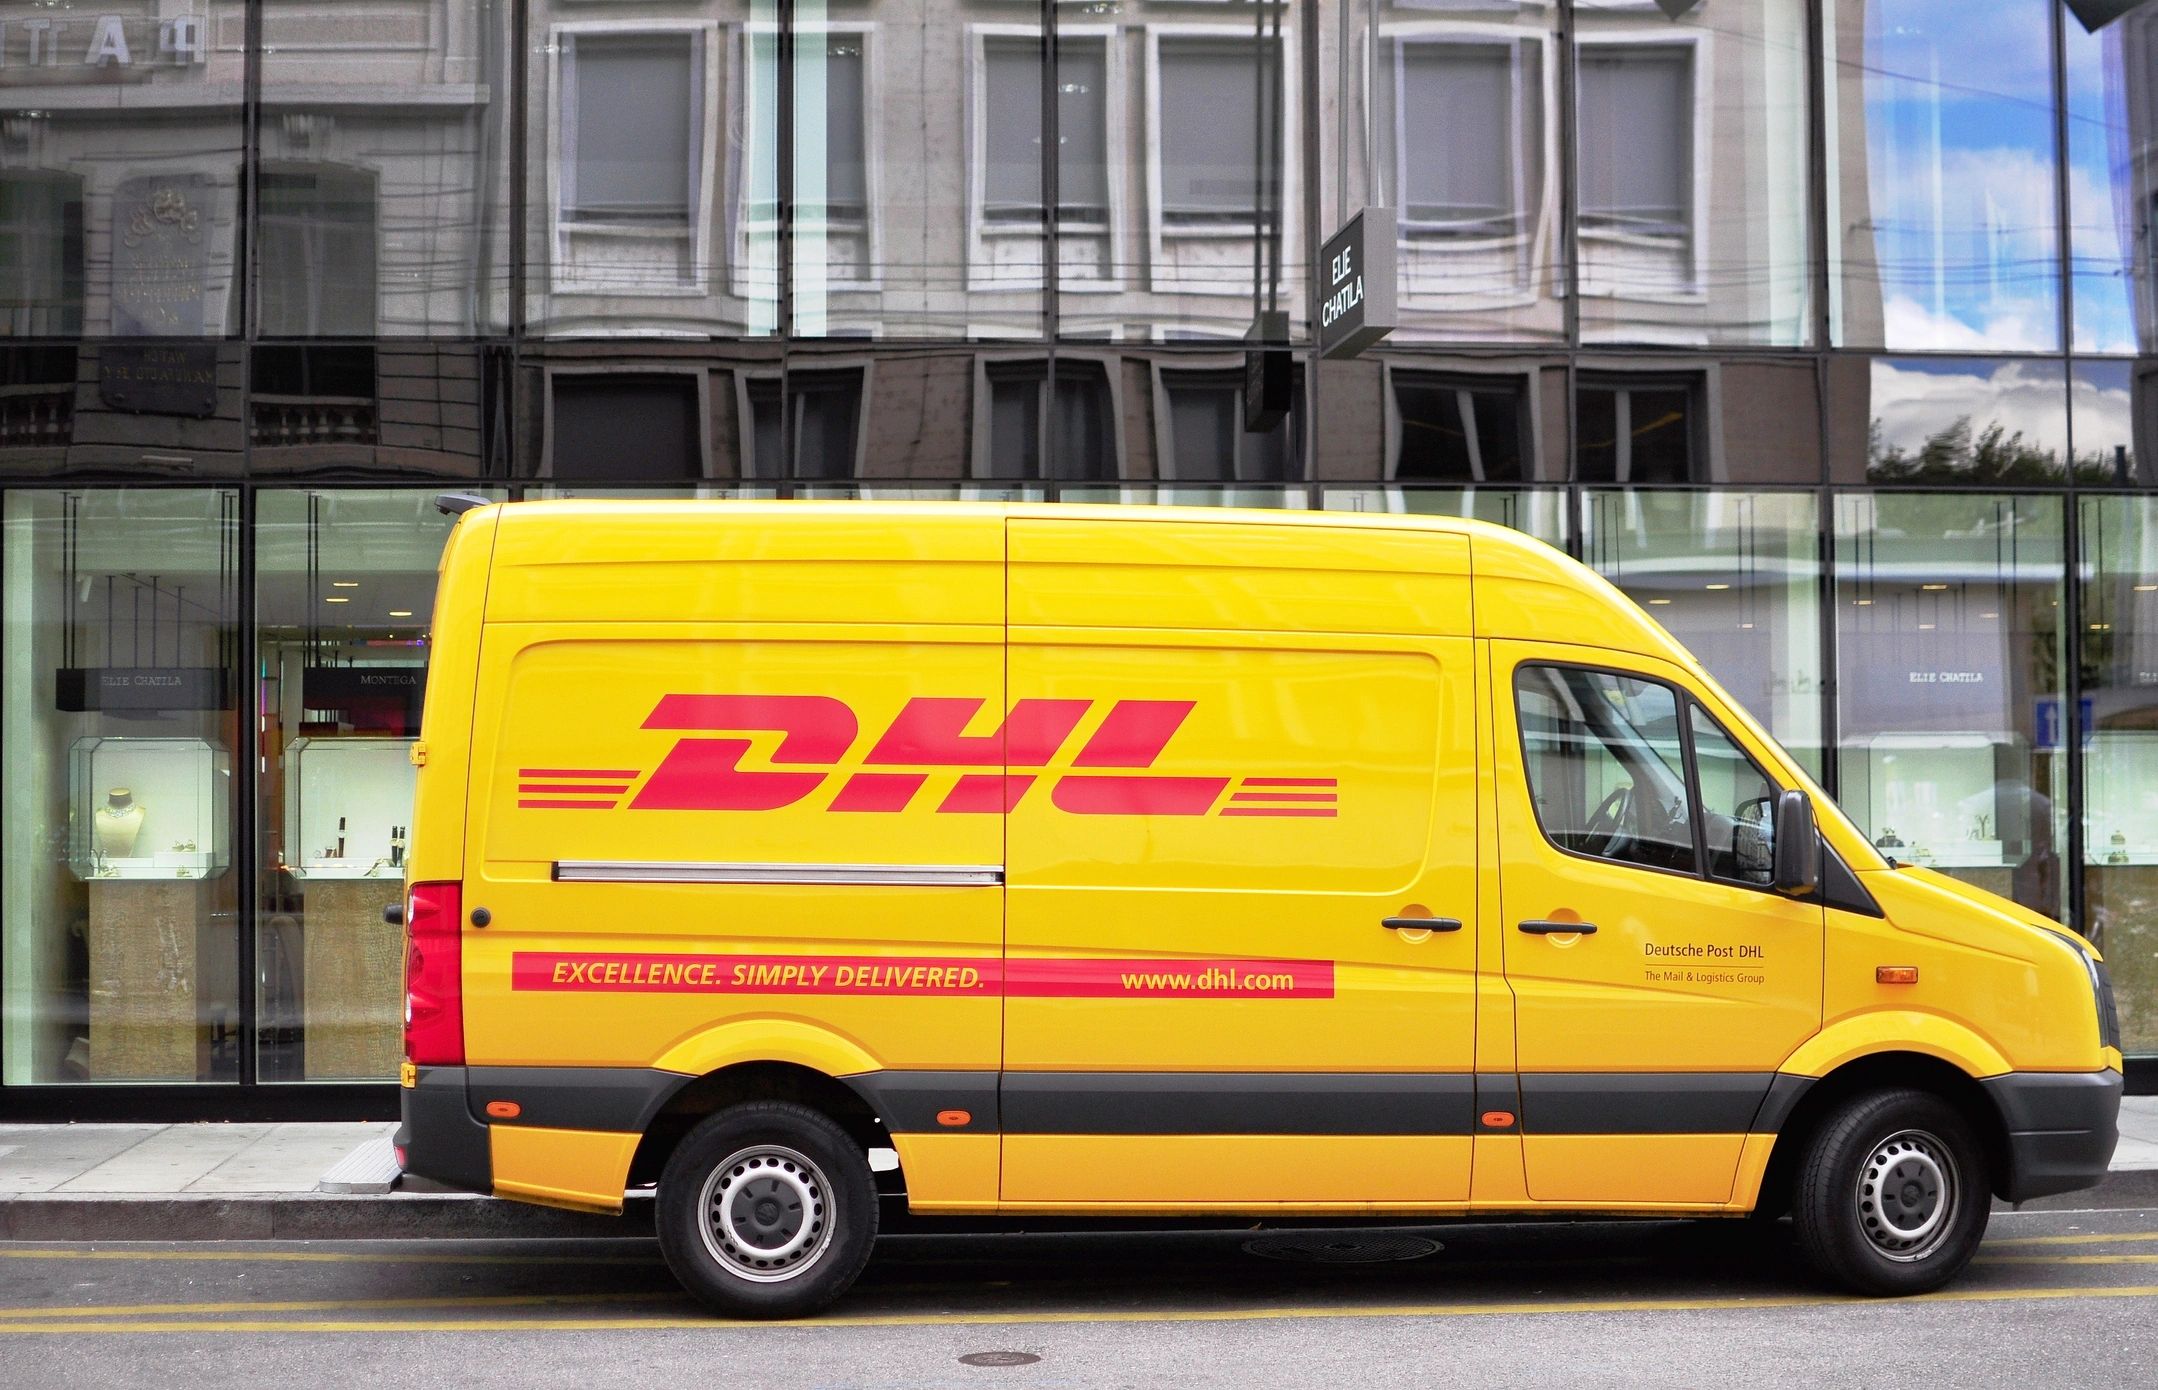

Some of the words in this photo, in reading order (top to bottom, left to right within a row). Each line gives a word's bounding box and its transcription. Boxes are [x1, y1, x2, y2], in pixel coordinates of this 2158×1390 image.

[1332, 245, 1351, 286] ELIE
[1322, 275, 1364, 328] CHATILA
[134, 676, 182, 686] CHATILA
[360, 675, 417, 685] MONTEGA
[1909, 672, 1936, 683] ELIE
[1940, 672, 1984, 683] CHATILA
[627, 694, 1232, 816] DHL
[1645, 943, 1703, 957] Deutsche
[1707, 944, 1734, 958] Post
[1739, 945, 1764, 958] DHL
[552, 962, 721, 985] EXCELLENCE.
[731, 965, 828, 987] SIMPLY
[834, 967, 985, 989] DELIVERED.
[1120, 968, 1294, 990] www.dhl.com
[1645, 970, 1661, 981] The
[1663, 971, 1684, 982] Mail
[1686, 971, 1694, 982] &
[1696, 972, 1735, 985] Logistics
[1737, 973, 1765, 985] Group
